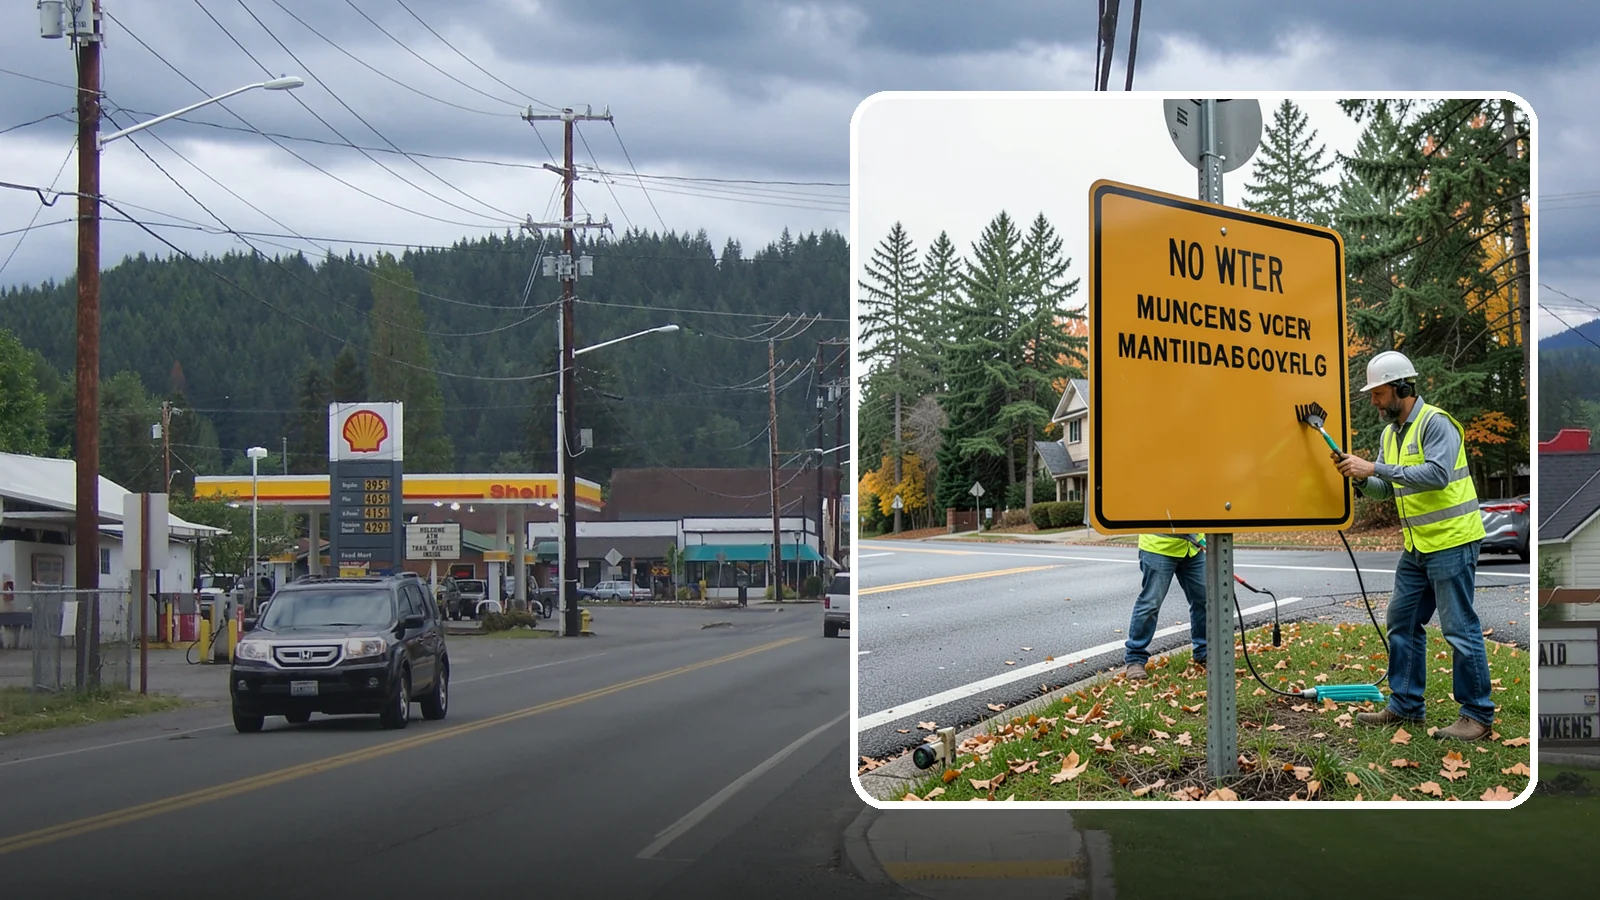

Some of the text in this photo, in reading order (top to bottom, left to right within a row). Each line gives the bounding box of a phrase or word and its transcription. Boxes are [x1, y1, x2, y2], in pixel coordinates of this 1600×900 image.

[1169, 238, 1284, 294] NO WTER
[366, 480, 383, 490] 395
[490, 484, 547, 498] Shell
[366, 494, 383, 504] 405
[366, 508, 383, 518] 415
[366, 522, 383, 533] 429
